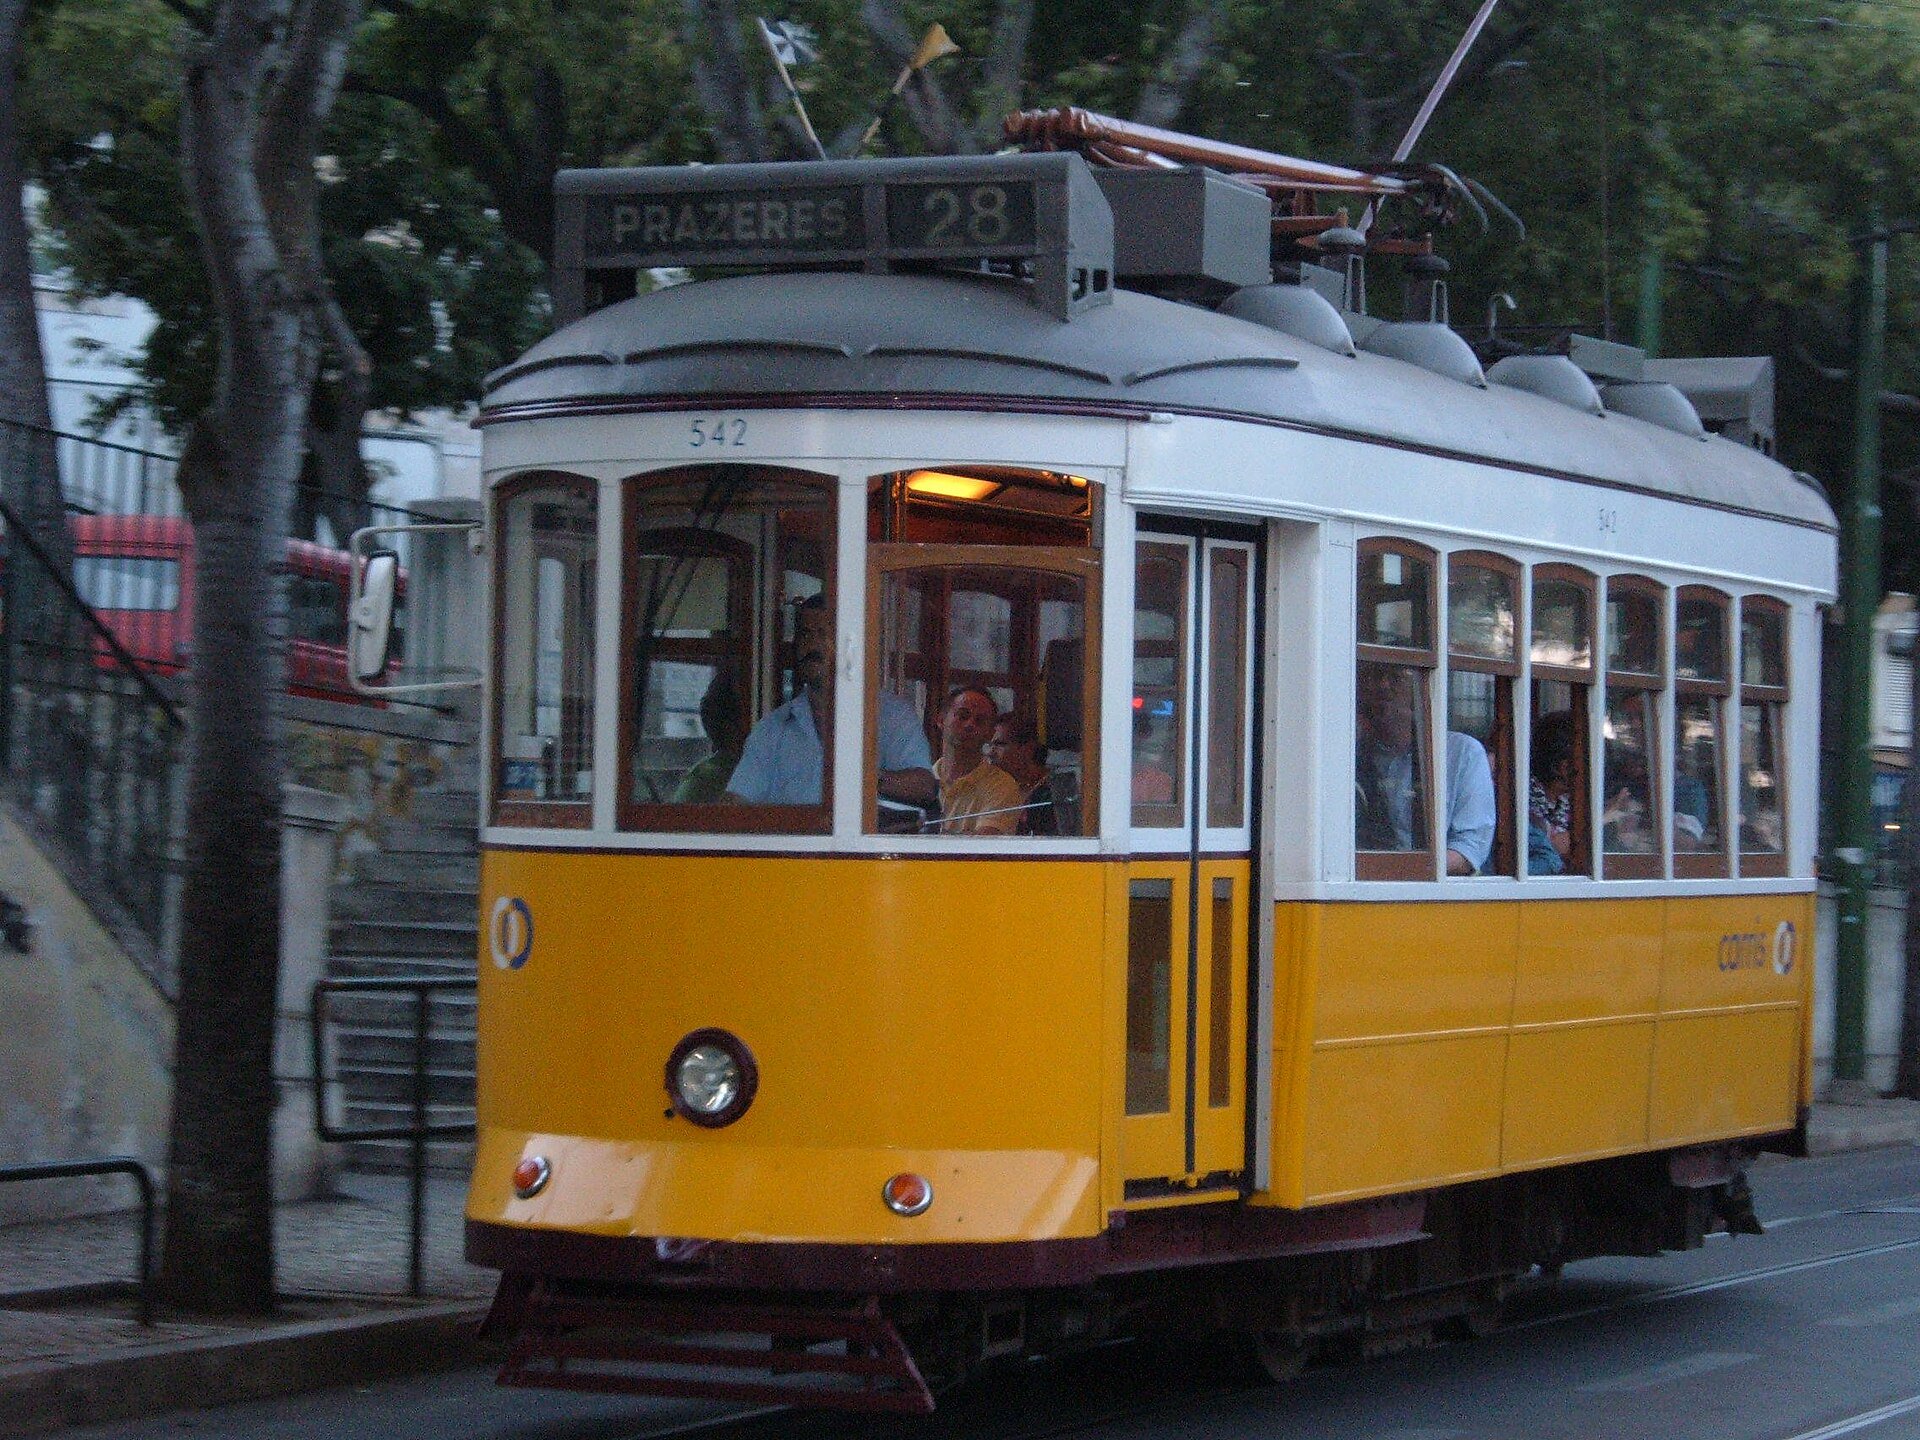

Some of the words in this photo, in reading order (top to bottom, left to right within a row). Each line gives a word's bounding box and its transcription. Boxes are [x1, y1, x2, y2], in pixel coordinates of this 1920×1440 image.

[613, 200, 850, 243] PRAZERES
[922, 186, 1009, 246] 28
[689, 419, 747, 447] 542
